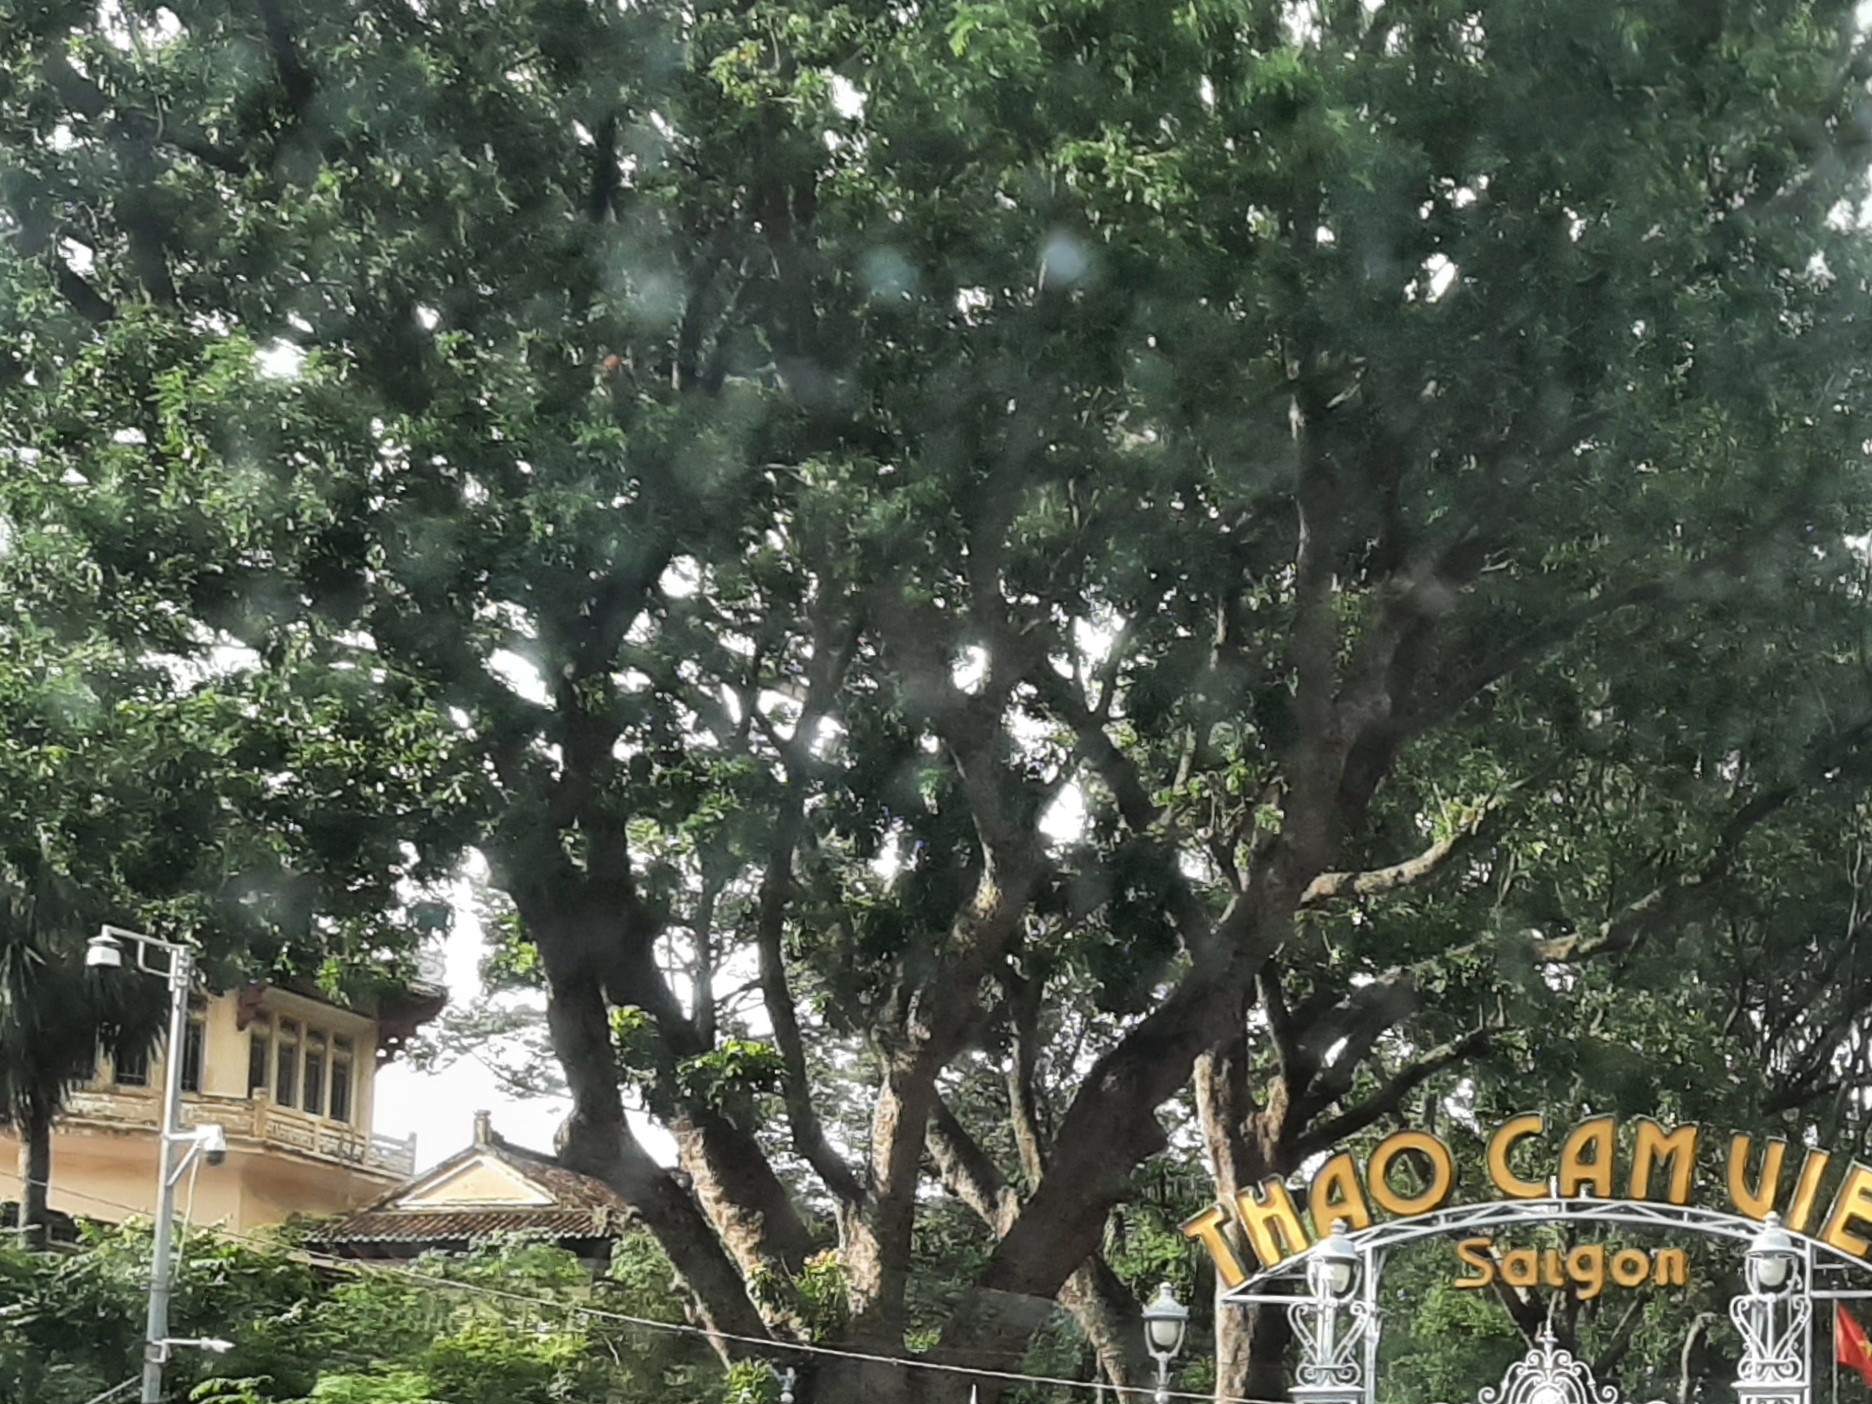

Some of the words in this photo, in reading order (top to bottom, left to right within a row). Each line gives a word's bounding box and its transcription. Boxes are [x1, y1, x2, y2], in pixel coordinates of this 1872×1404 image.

[1181, 1131, 1454, 1289] THAO
[1487, 1113, 1698, 1205] CAM
[1454, 1237, 1688, 1300] Saigon
